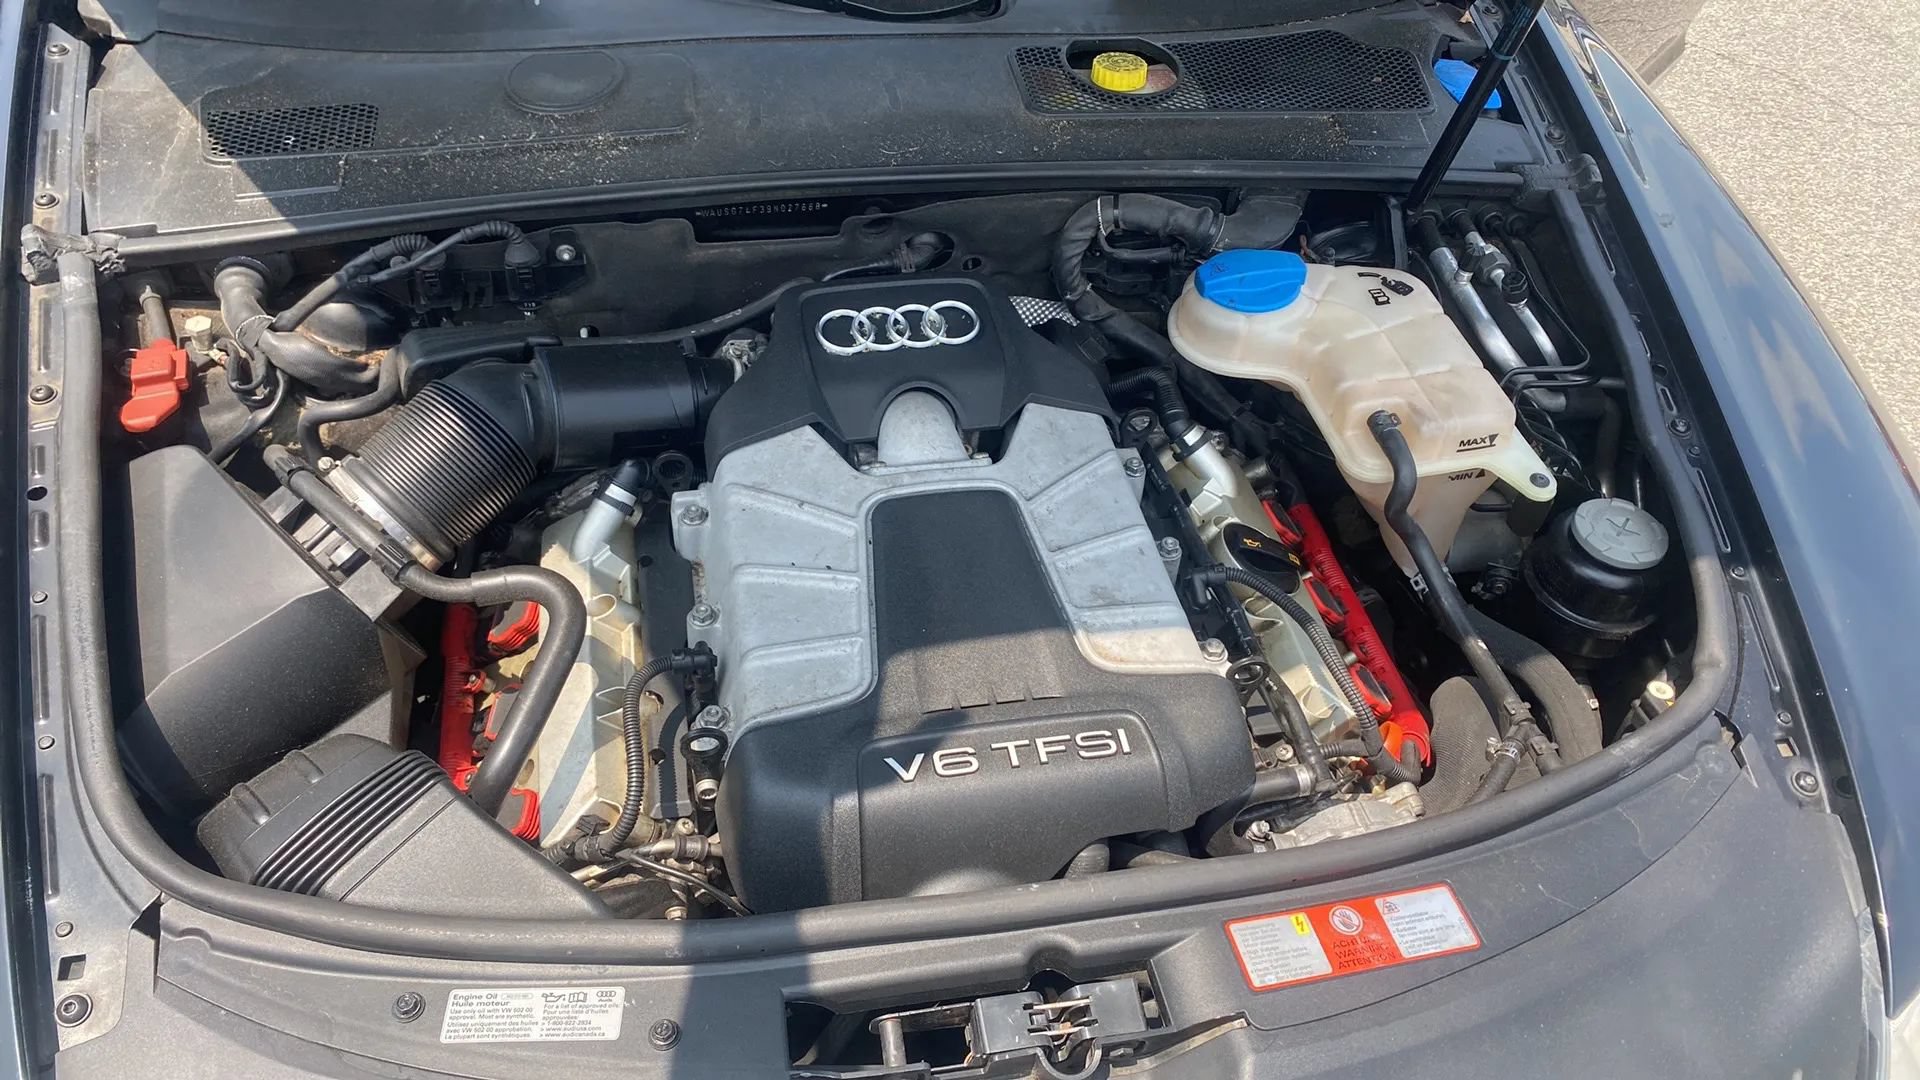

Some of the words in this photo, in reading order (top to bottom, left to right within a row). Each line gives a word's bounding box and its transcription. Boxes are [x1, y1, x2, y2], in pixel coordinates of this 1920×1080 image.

[1459, 436, 1488, 447] MAX
[884, 747, 980, 782] V6
[990, 728, 1132, 768] TFSI
